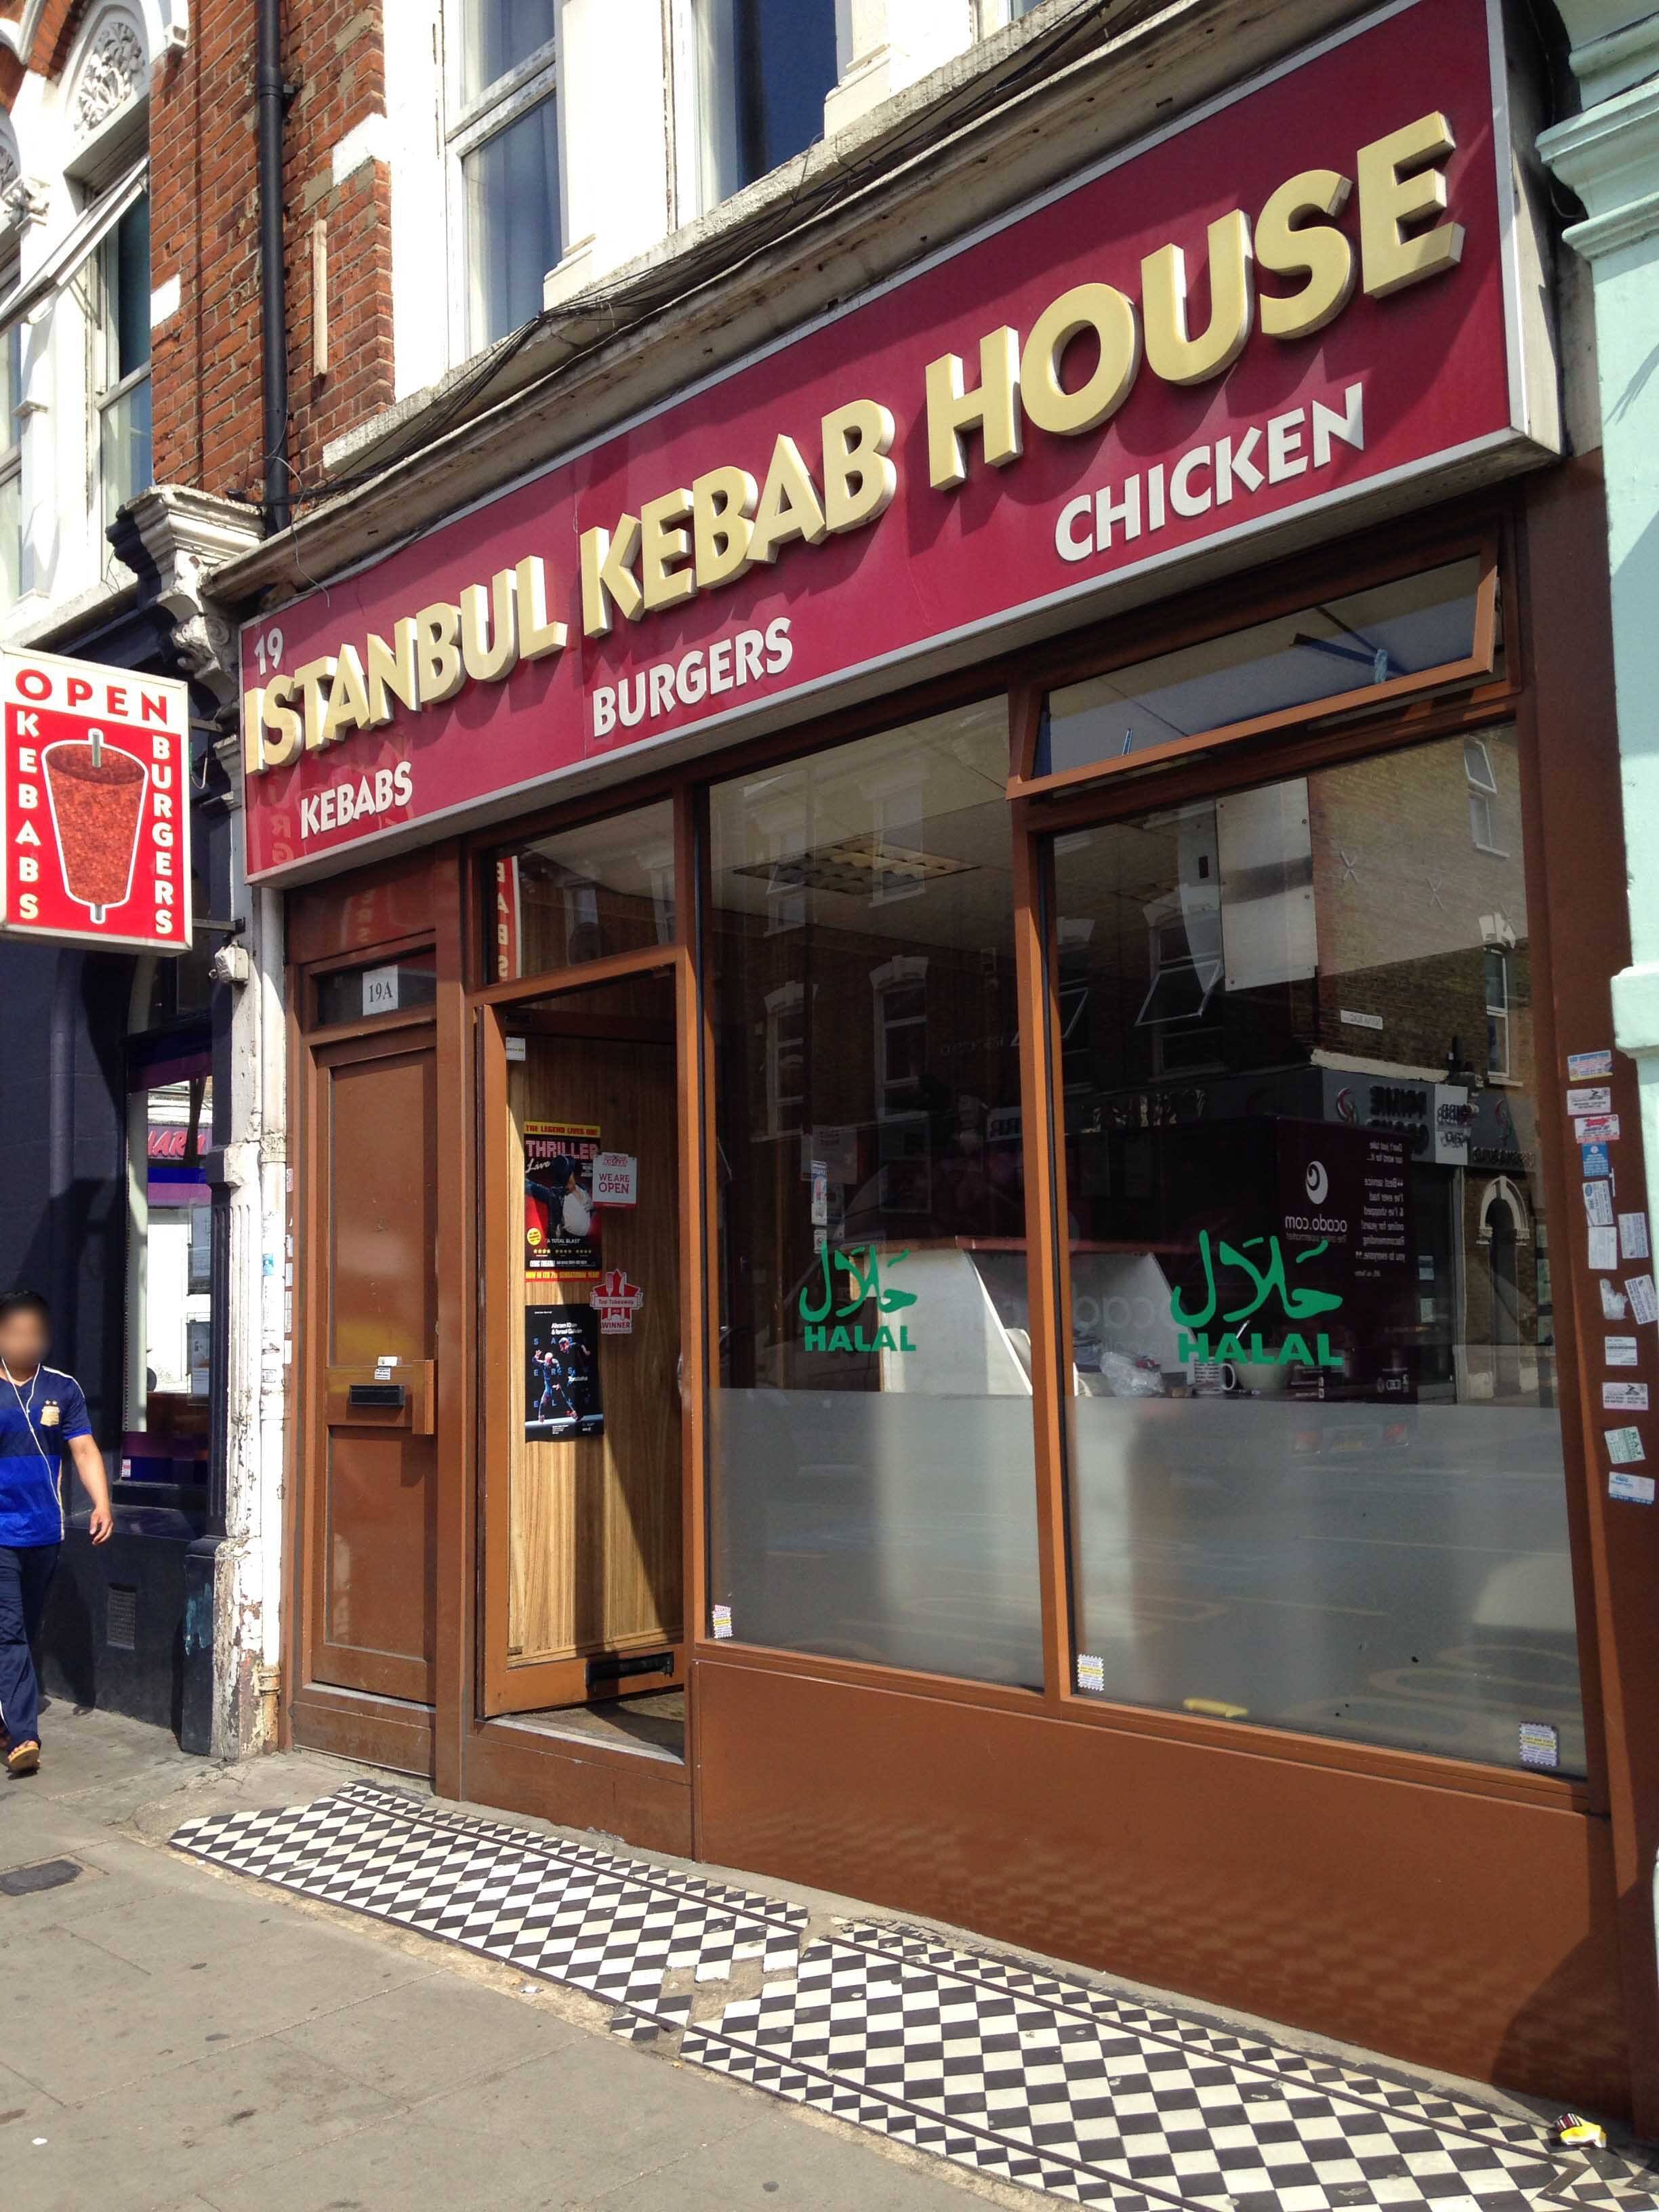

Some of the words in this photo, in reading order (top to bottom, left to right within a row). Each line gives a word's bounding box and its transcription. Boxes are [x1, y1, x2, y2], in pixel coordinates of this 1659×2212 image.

[243, 555, 568, 775] ISTANBUL
[580, 398, 897, 639] KEBAB
[925, 110, 1465, 492] HOUSE
[300, 761, 413, 840] KEBABS
[592, 617, 794, 738] BURGERS
[1054, 382, 1364, 562] CHICKEN
[253, 628, 284, 675] 19
[15, 668, 168, 725] OPEN
[15, 710, 41, 920] KEBABS
[152, 736, 174, 935] BURGERS
[369, 981, 393, 1003] 19A
[525, 1140, 599, 1160] THRILLER
[525, 1158, 551, 1174] Live
[598, 1182, 630, 1194] OPEN
[599, 1173, 613, 1181] WE
[615, 1174, 630, 1183] ARE
[804, 1325, 917, 1352] HALAL
[1177, 1333, 1344, 1367] HALAL
